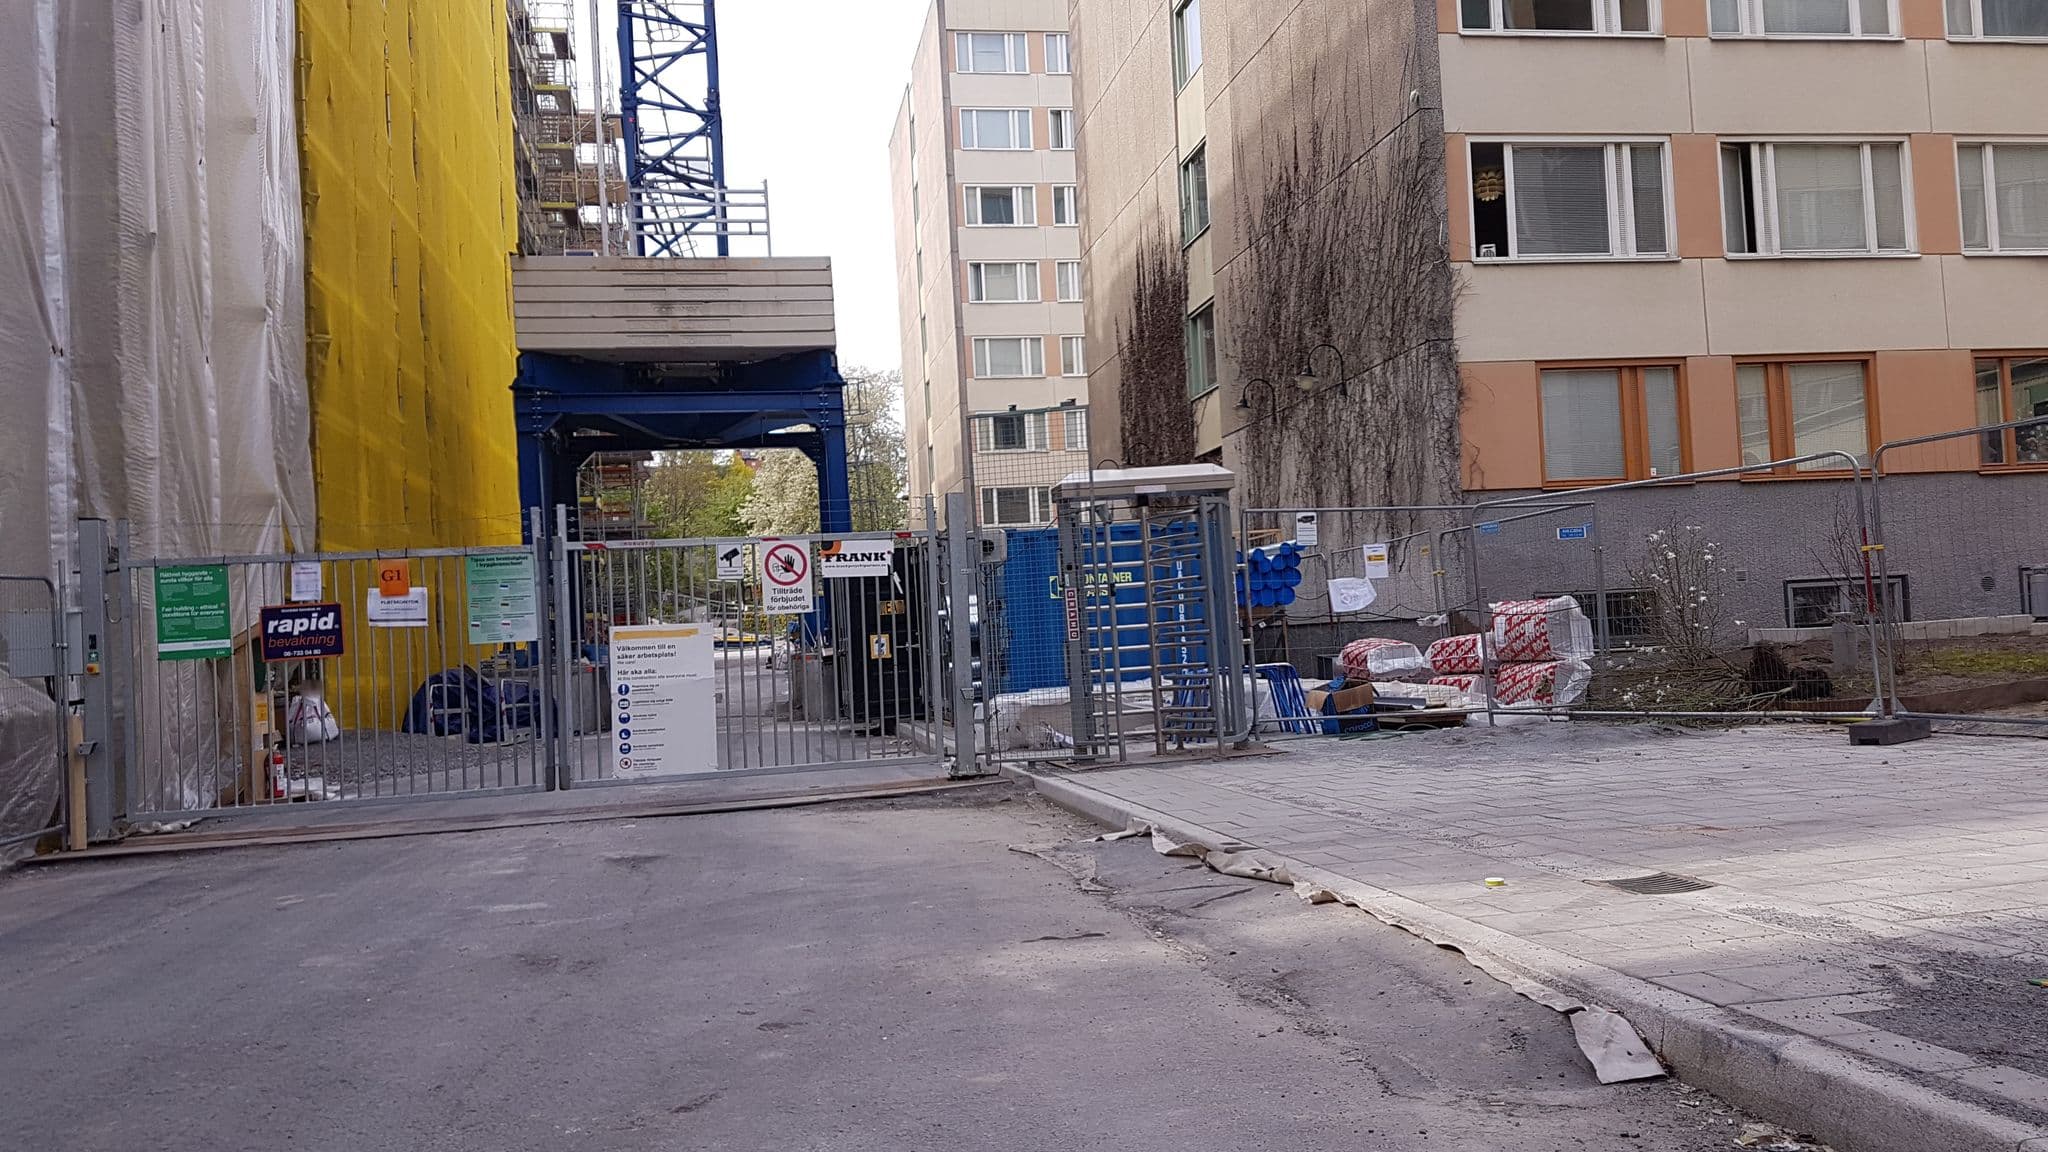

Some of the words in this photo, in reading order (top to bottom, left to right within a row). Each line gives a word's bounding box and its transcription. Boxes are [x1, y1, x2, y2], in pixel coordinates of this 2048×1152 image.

[825, 552, 886, 562] FRANK
[381, 569, 401, 581] G1
[772, 587, 803, 595] Tillträde
[771, 595, 805, 603] förbjudet
[778, 603, 810, 611] obehöriga
[267, 612, 335, 636] rapid
[268, 634, 336, 648] bevakning
[637, 651, 677, 659] arbetsplats!
